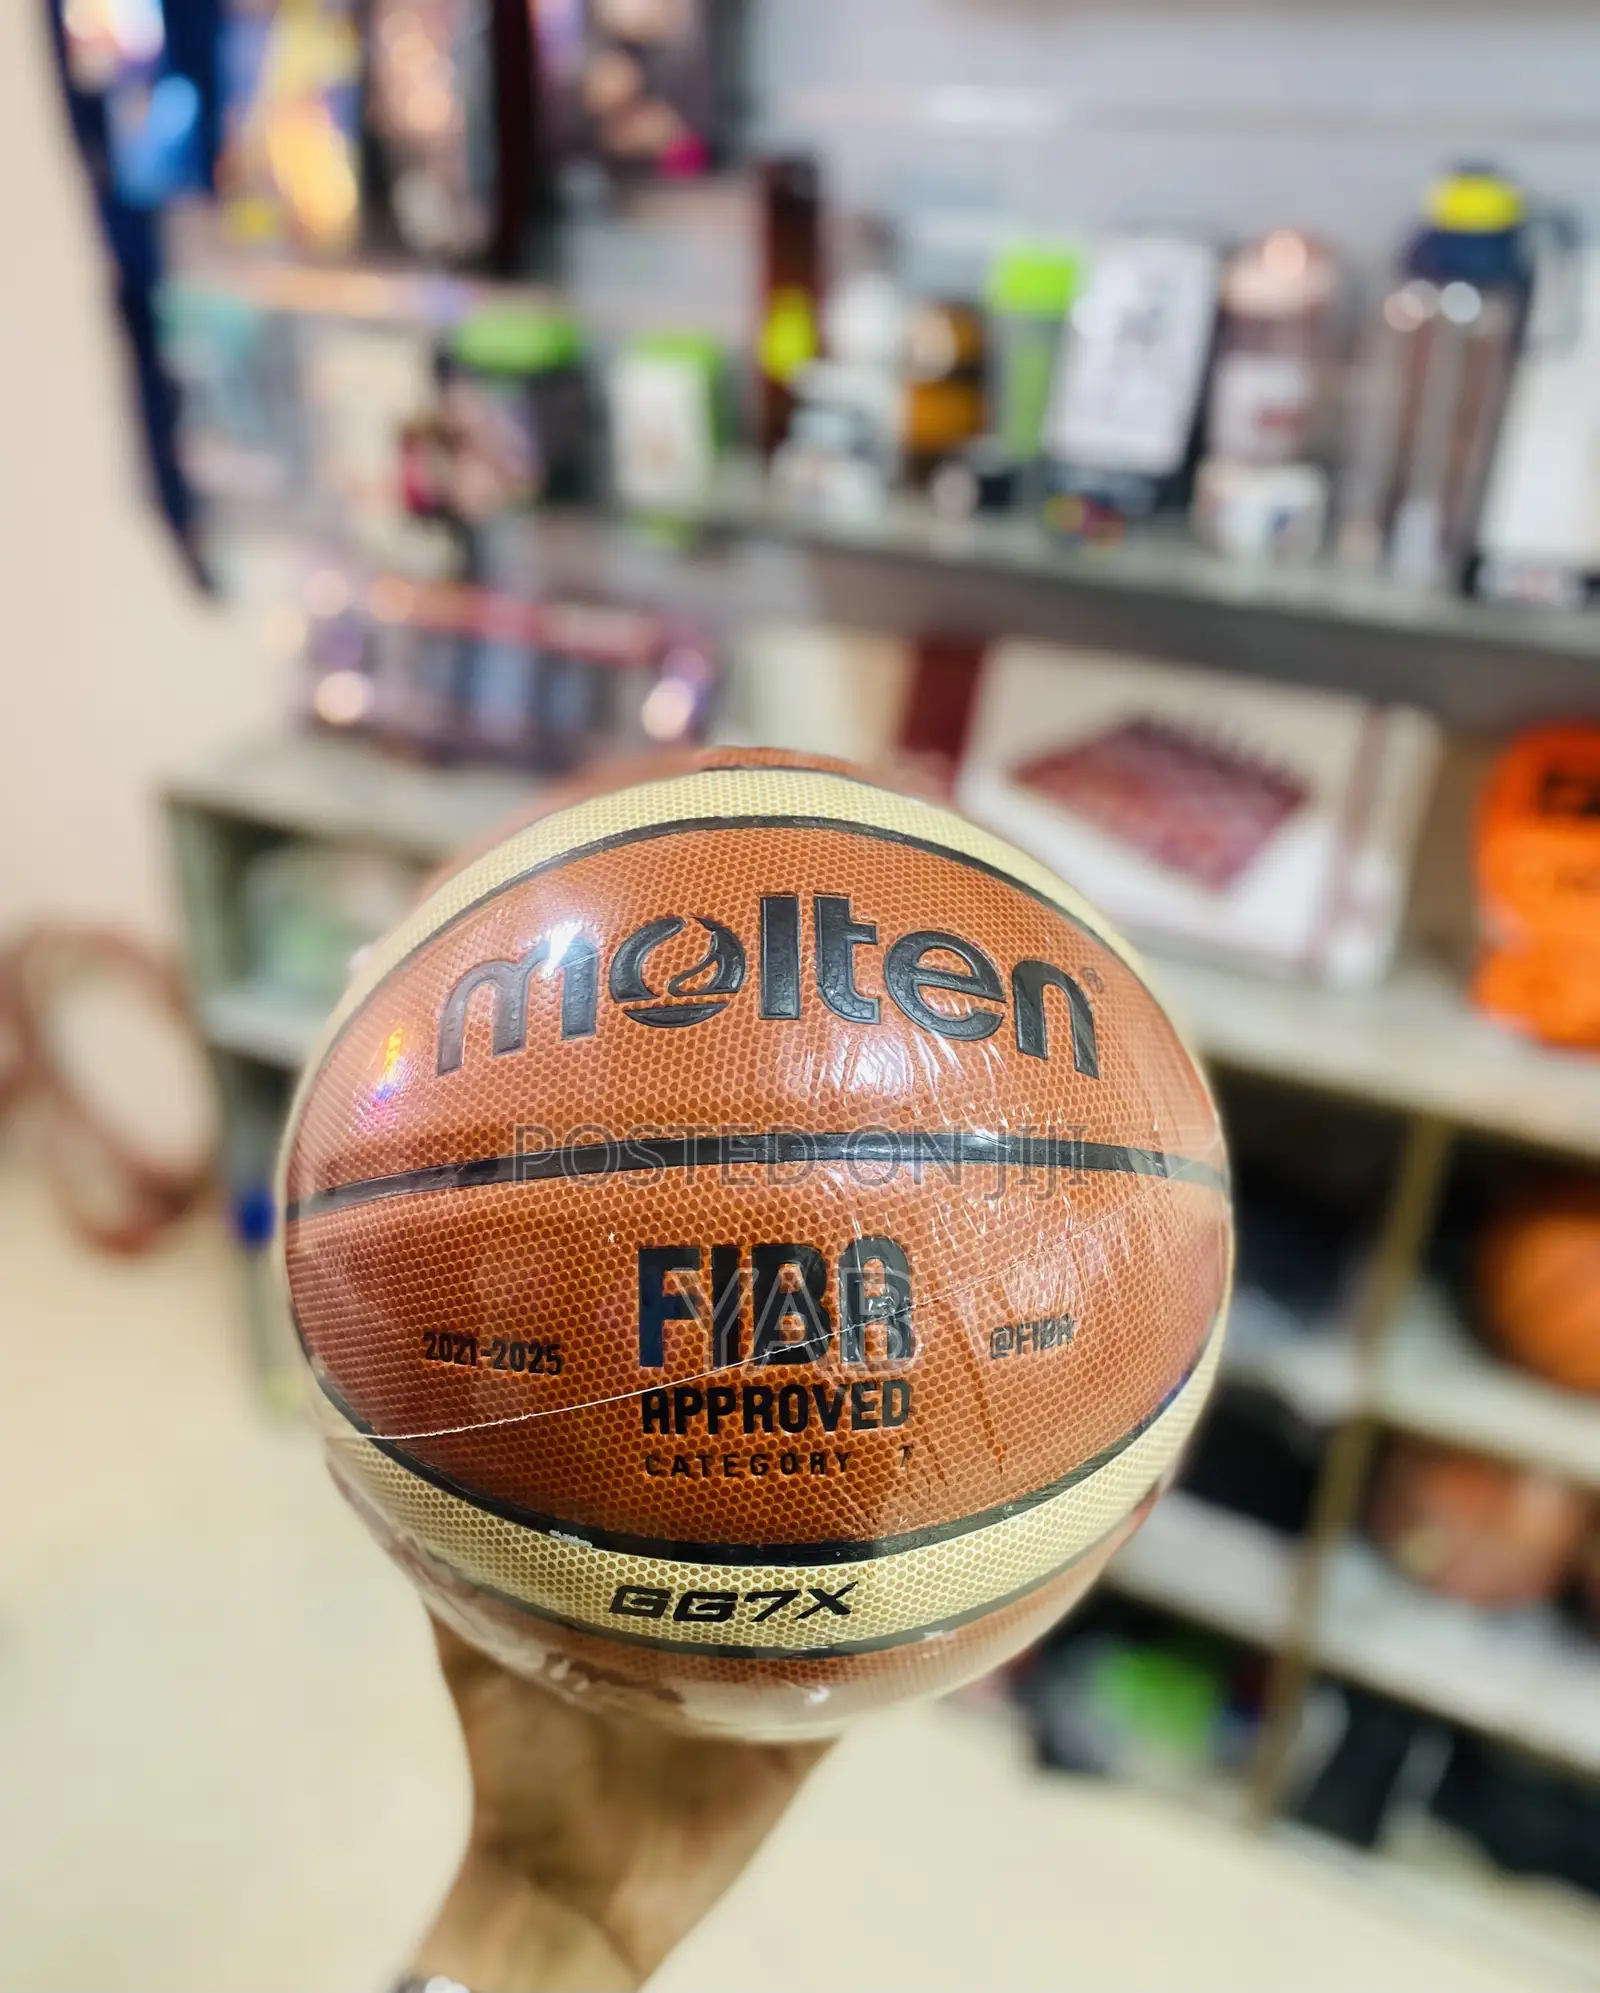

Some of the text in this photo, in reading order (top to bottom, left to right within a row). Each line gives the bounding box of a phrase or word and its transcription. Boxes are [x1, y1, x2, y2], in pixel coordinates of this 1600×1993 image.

[436, 893, 1099, 1079] molten
[638, 1235, 912, 1368] FIBA
[423, 1331, 564, 1376] 2021-2025
[641, 1379, 912, 1435] APPROVED
[645, 1450, 851, 1478] CATEGORY
[608, 1580, 860, 1623] GG7X
